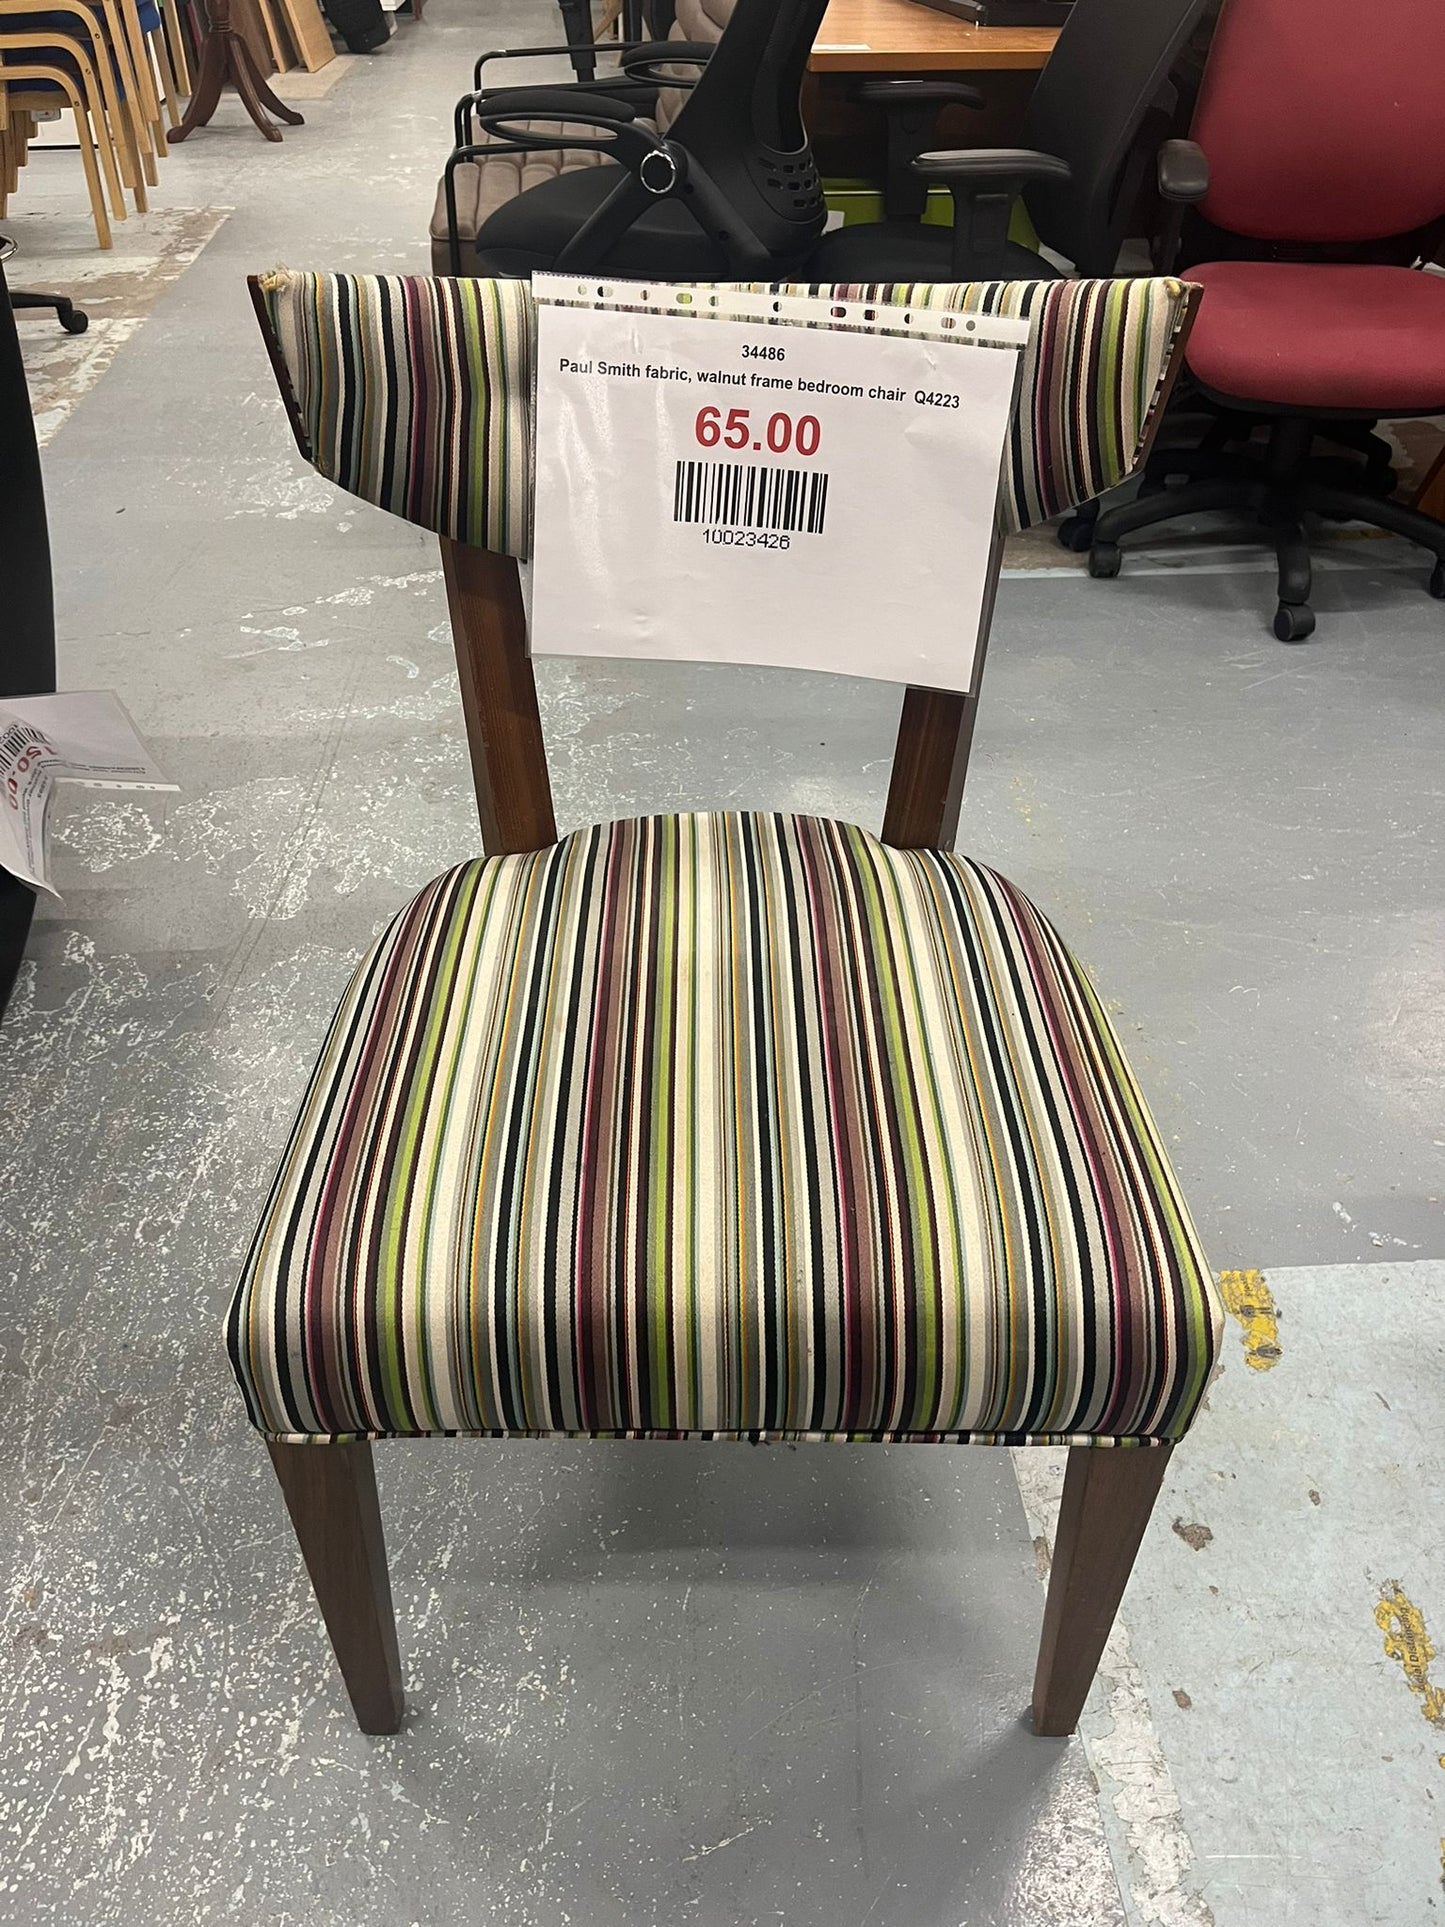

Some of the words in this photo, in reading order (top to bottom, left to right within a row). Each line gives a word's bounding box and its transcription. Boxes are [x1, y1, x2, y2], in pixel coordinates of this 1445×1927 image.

[741, 344, 786, 362] 34486
[559, 358, 593, 374] Paul
[597, 361, 641, 378] Smith
[645, 364, 692, 384] fabric,
[696, 370, 747, 387] walnut
[750, 373, 793, 390] frame
[797, 377, 864, 398] bedroom
[868, 385, 907, 402] chair
[914, 390, 960, 409] Q4223
[695, 405, 821, 457] 65.00
[702, 528, 791, 550] 10023426
